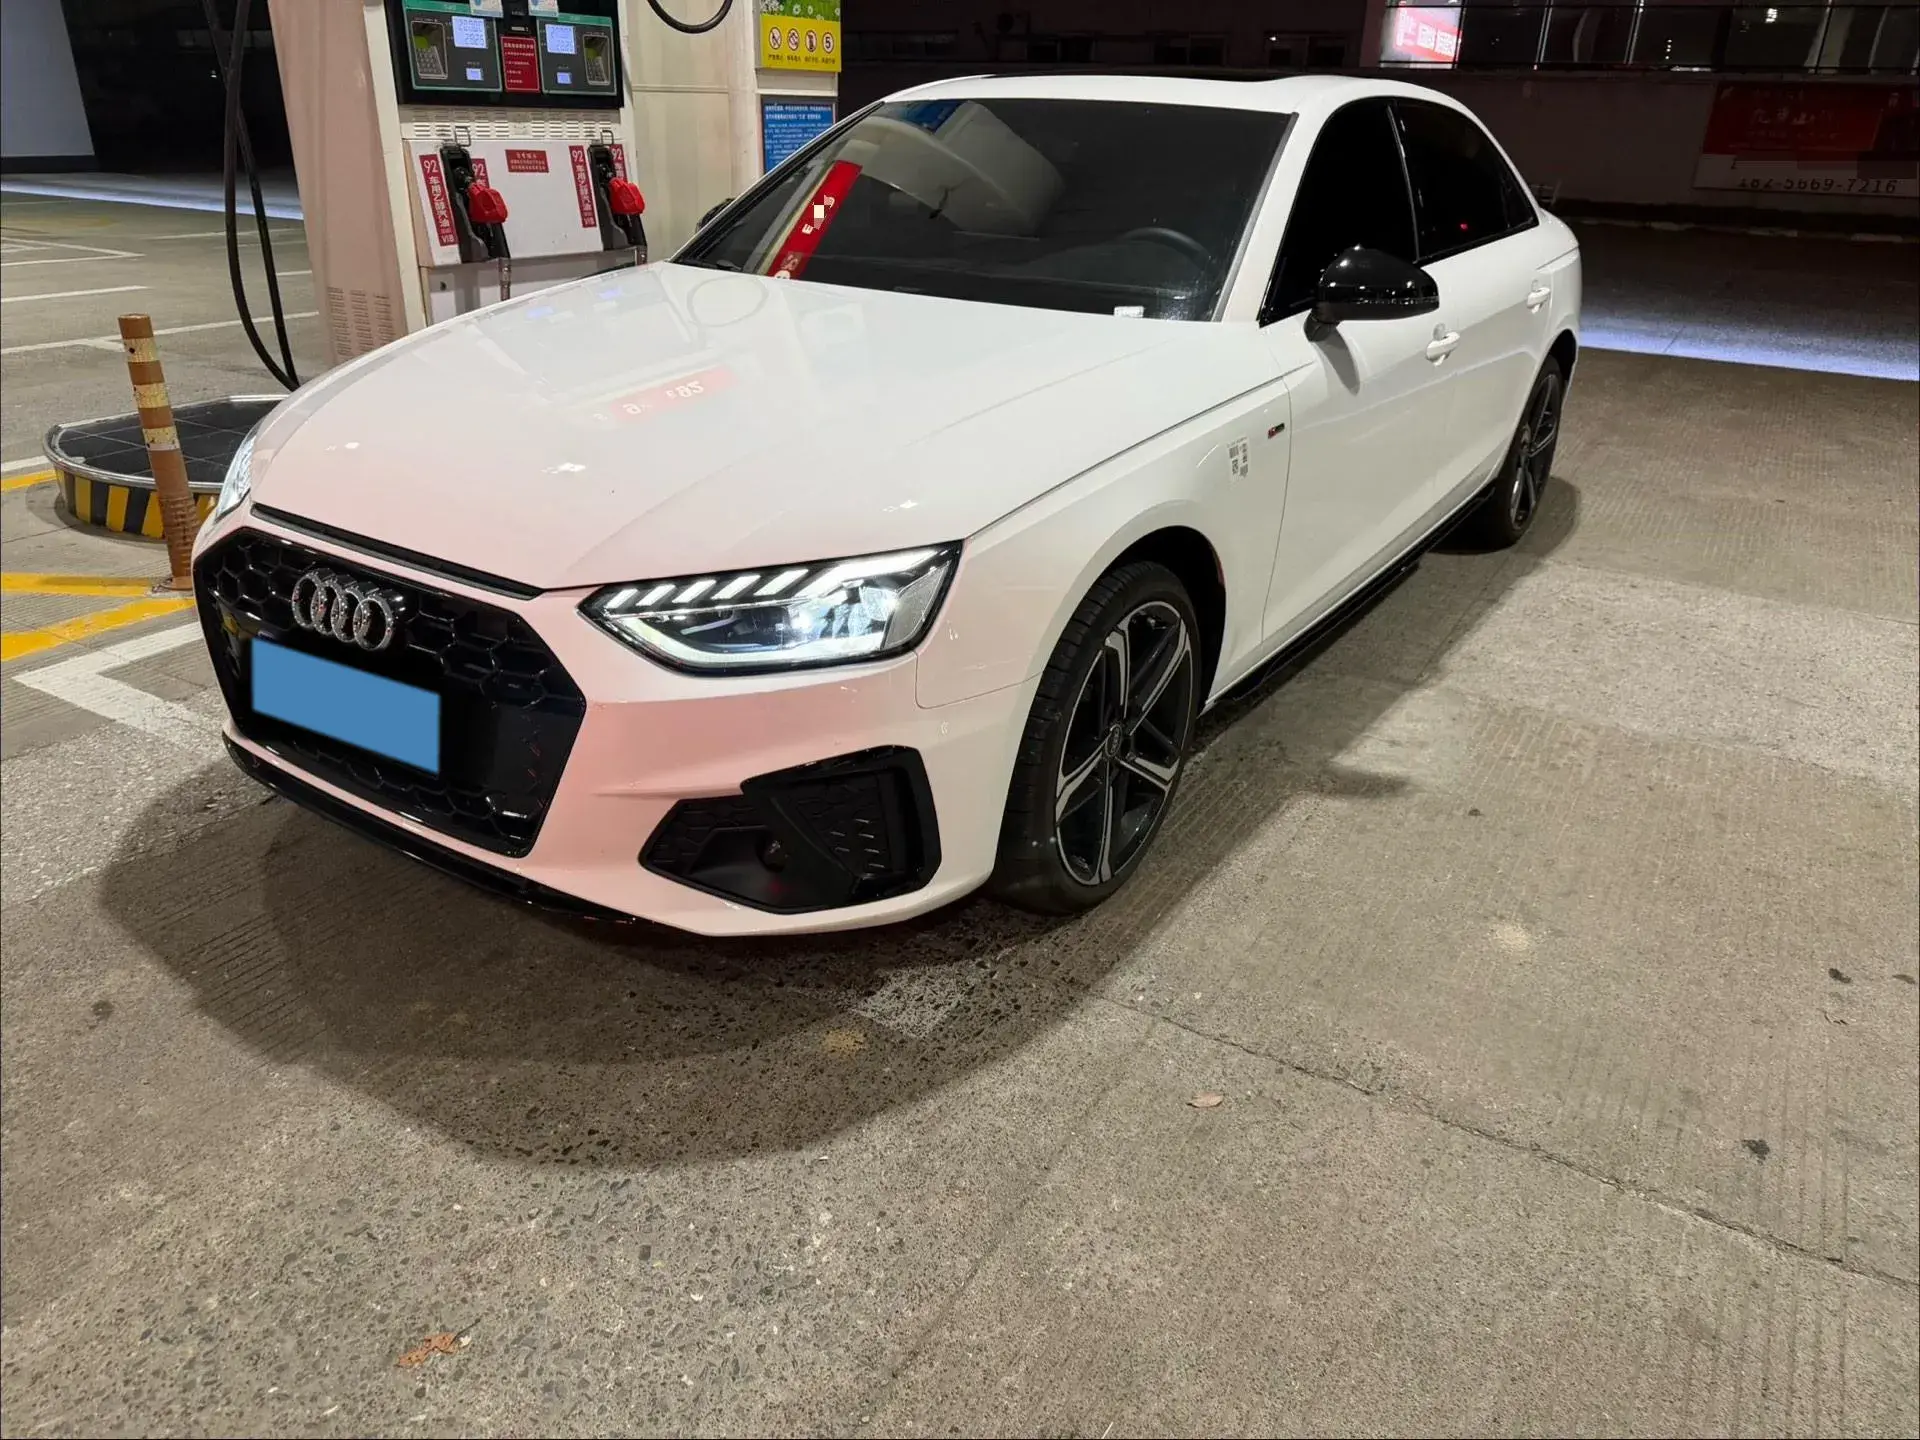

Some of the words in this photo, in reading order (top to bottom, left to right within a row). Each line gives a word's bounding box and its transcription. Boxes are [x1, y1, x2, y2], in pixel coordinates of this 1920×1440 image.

[824, 36, 831, 49] 5
[572, 150, 584, 162] 92
[612, 147, 624, 161] 92
[424, 160, 439, 173] 92
[472, 163, 486, 176] 92
